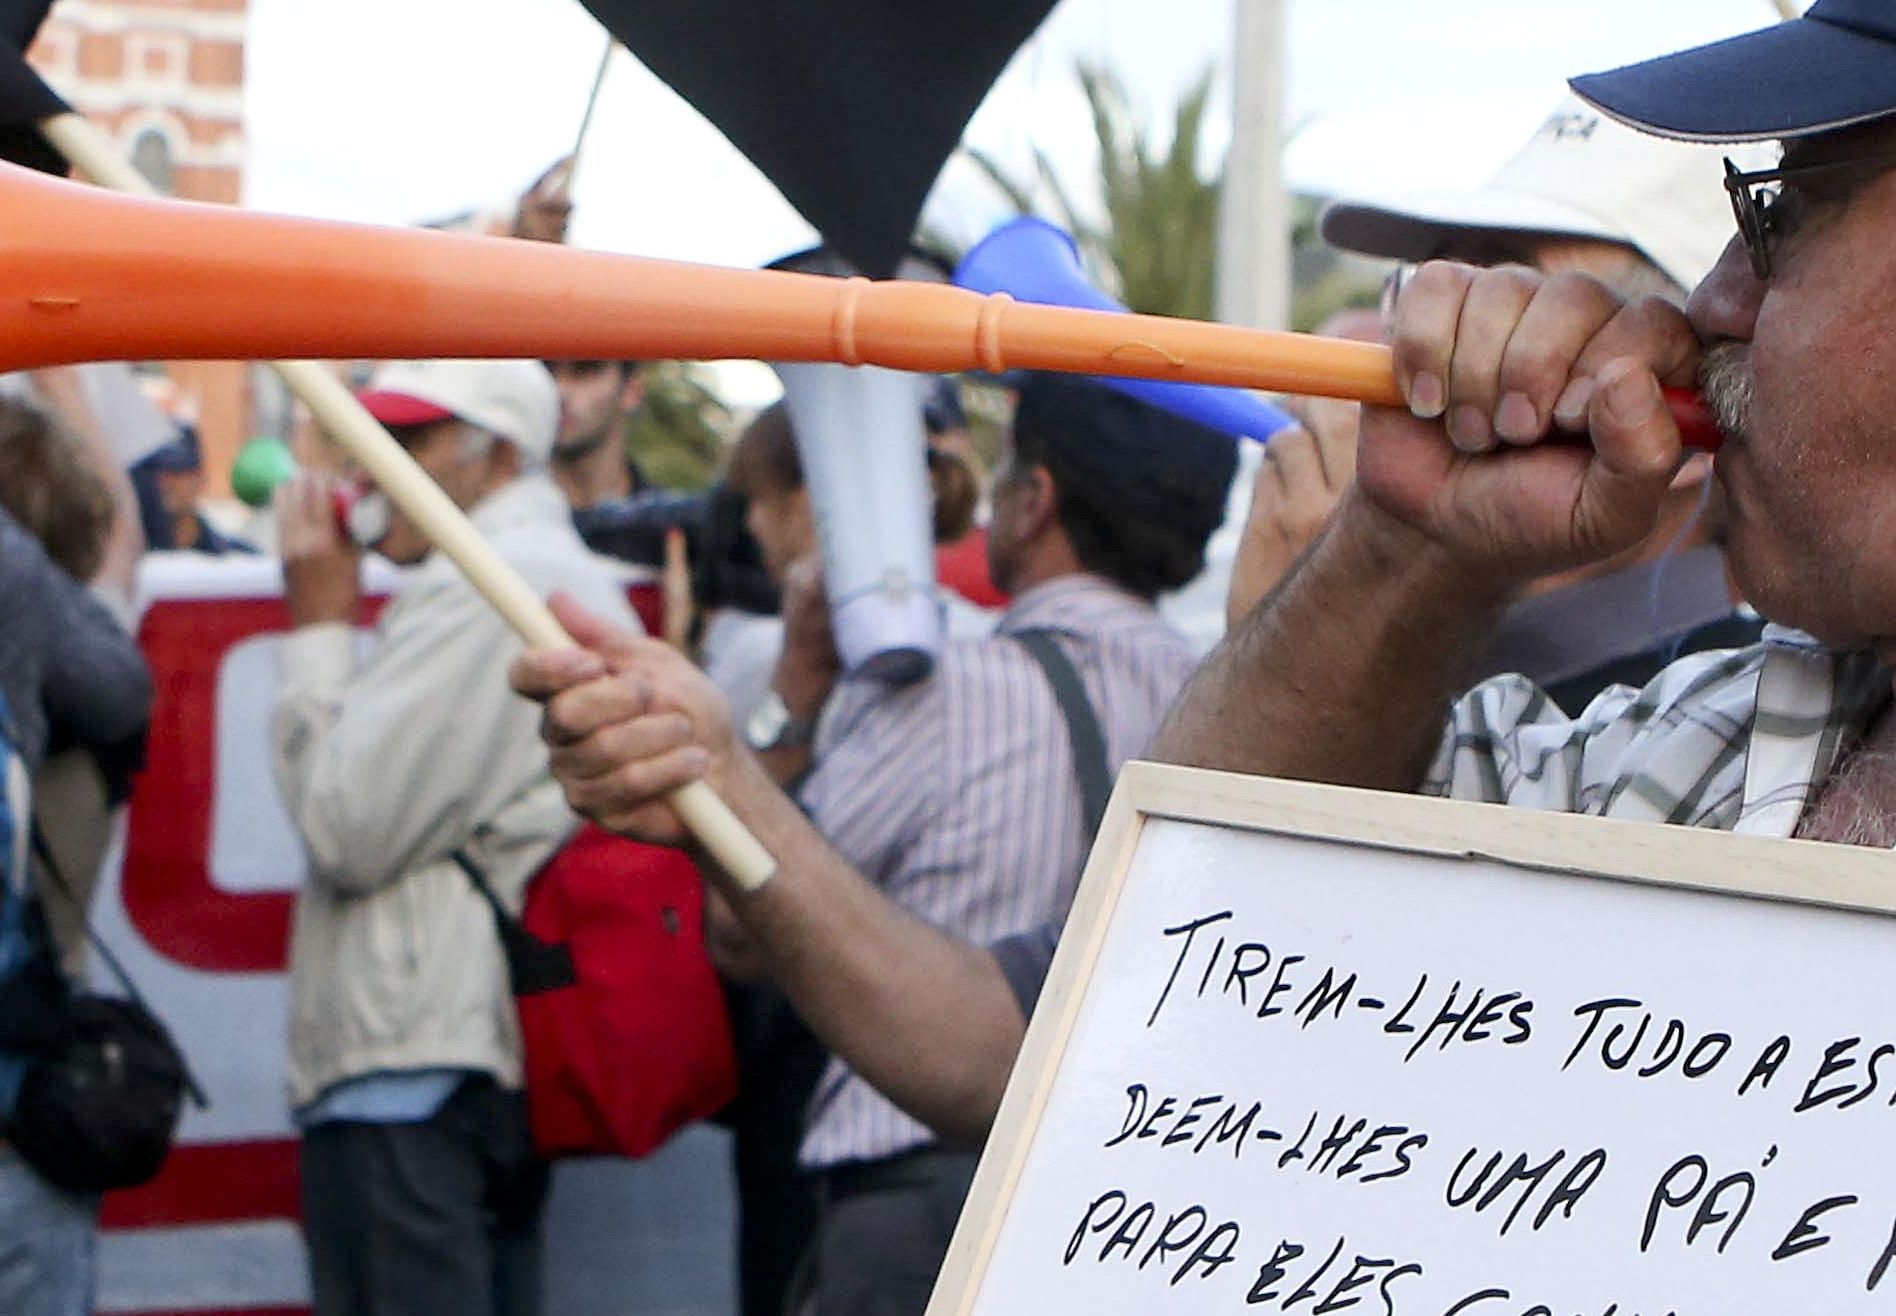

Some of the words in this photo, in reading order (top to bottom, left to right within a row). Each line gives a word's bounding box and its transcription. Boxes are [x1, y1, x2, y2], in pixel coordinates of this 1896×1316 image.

[1146, 909, 1535, 1064] TIREM-LHES
[1560, 997, 1733, 1080] TUDO
[1736, 1034, 1792, 1097] A
[1062, 1188, 1241, 1287] PARA
[1103, 1082, 1430, 1184] DEEM-LHES
[1445, 1146, 1608, 1237] UMA
[1639, 1143, 1779, 1255] PÁ
[1770, 1194, 1860, 1262] E
